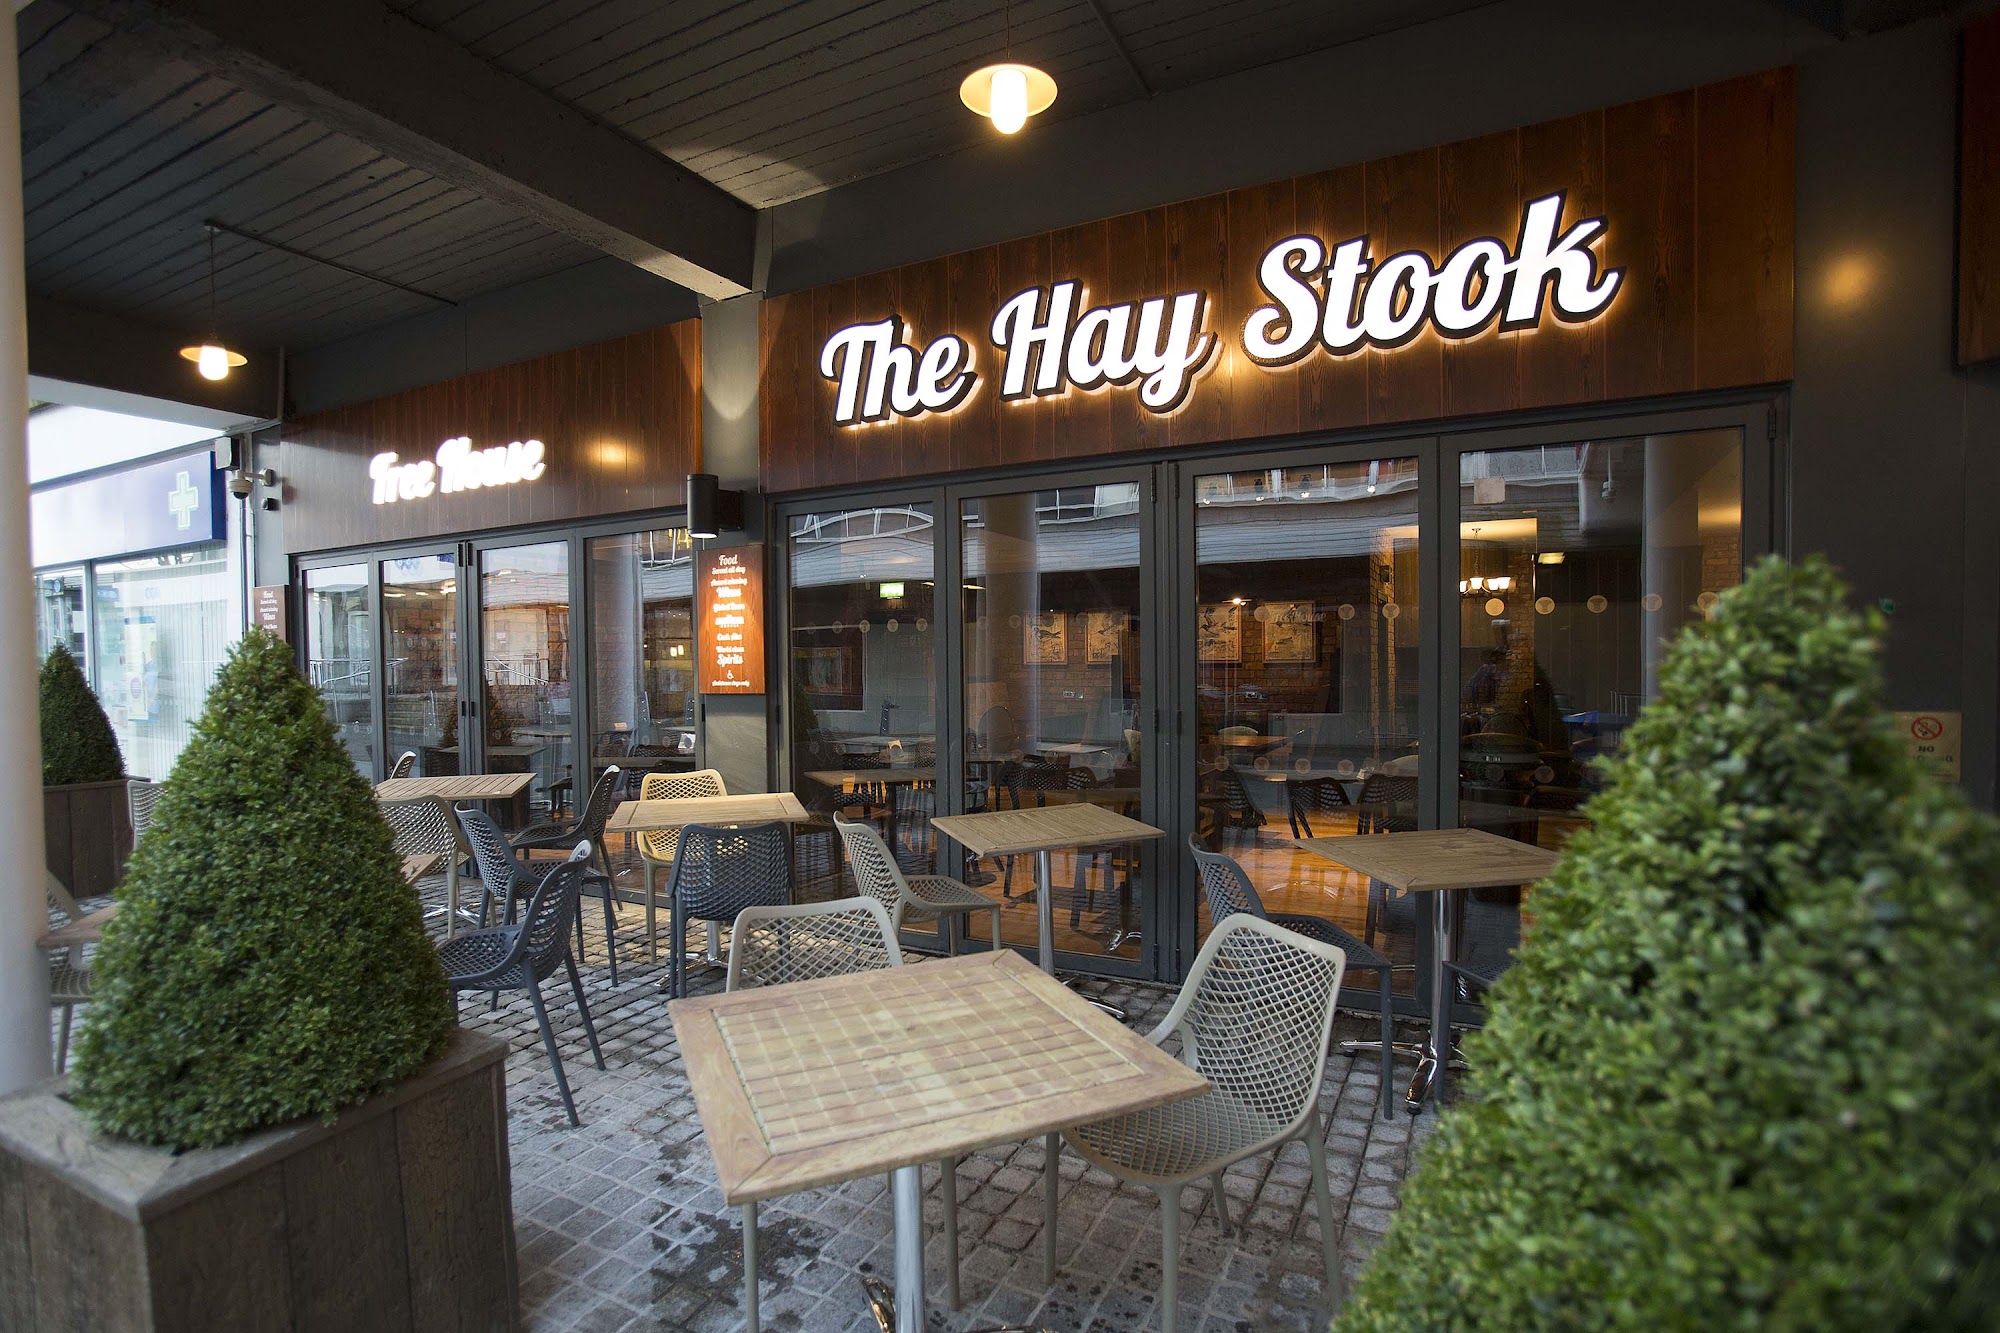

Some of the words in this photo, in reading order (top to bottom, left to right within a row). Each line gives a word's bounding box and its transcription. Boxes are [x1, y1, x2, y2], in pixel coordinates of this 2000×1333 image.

[821, 316, 975, 426] The
[991, 278, 1217, 414] Hay
[1240, 190, 1625, 368] Stook
[719, 554, 738, 566] Food
[717, 653, 744, 667] Spirits
